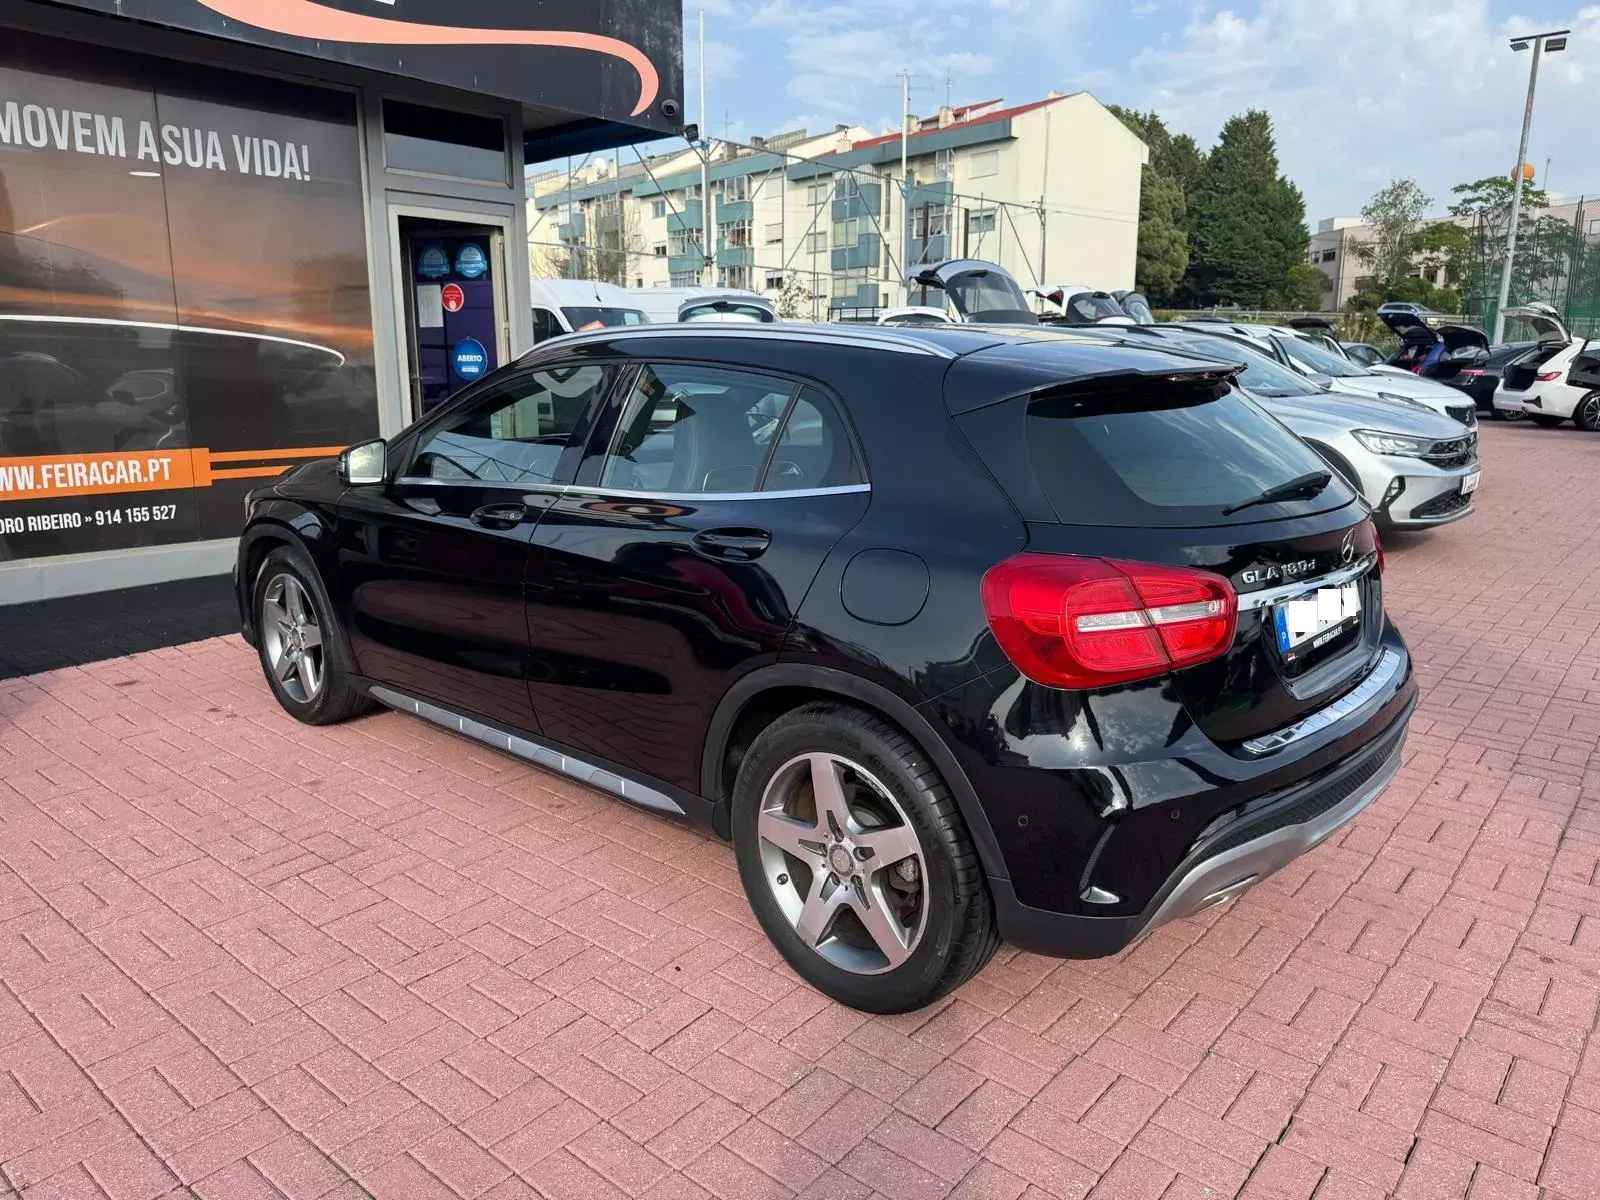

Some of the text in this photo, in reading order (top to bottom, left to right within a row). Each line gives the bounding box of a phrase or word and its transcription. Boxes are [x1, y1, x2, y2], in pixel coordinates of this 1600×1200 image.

[0, 101, 127, 159] MOVEM
[232, 134, 311, 182] VIDA!
[457, 354, 483, 362] ABERTO
[27, 512, 82, 532] RIBEIRO
[95, 510, 122, 526] 914
[125, 506, 150, 523] 155
[152, 504, 177, 520] 527
